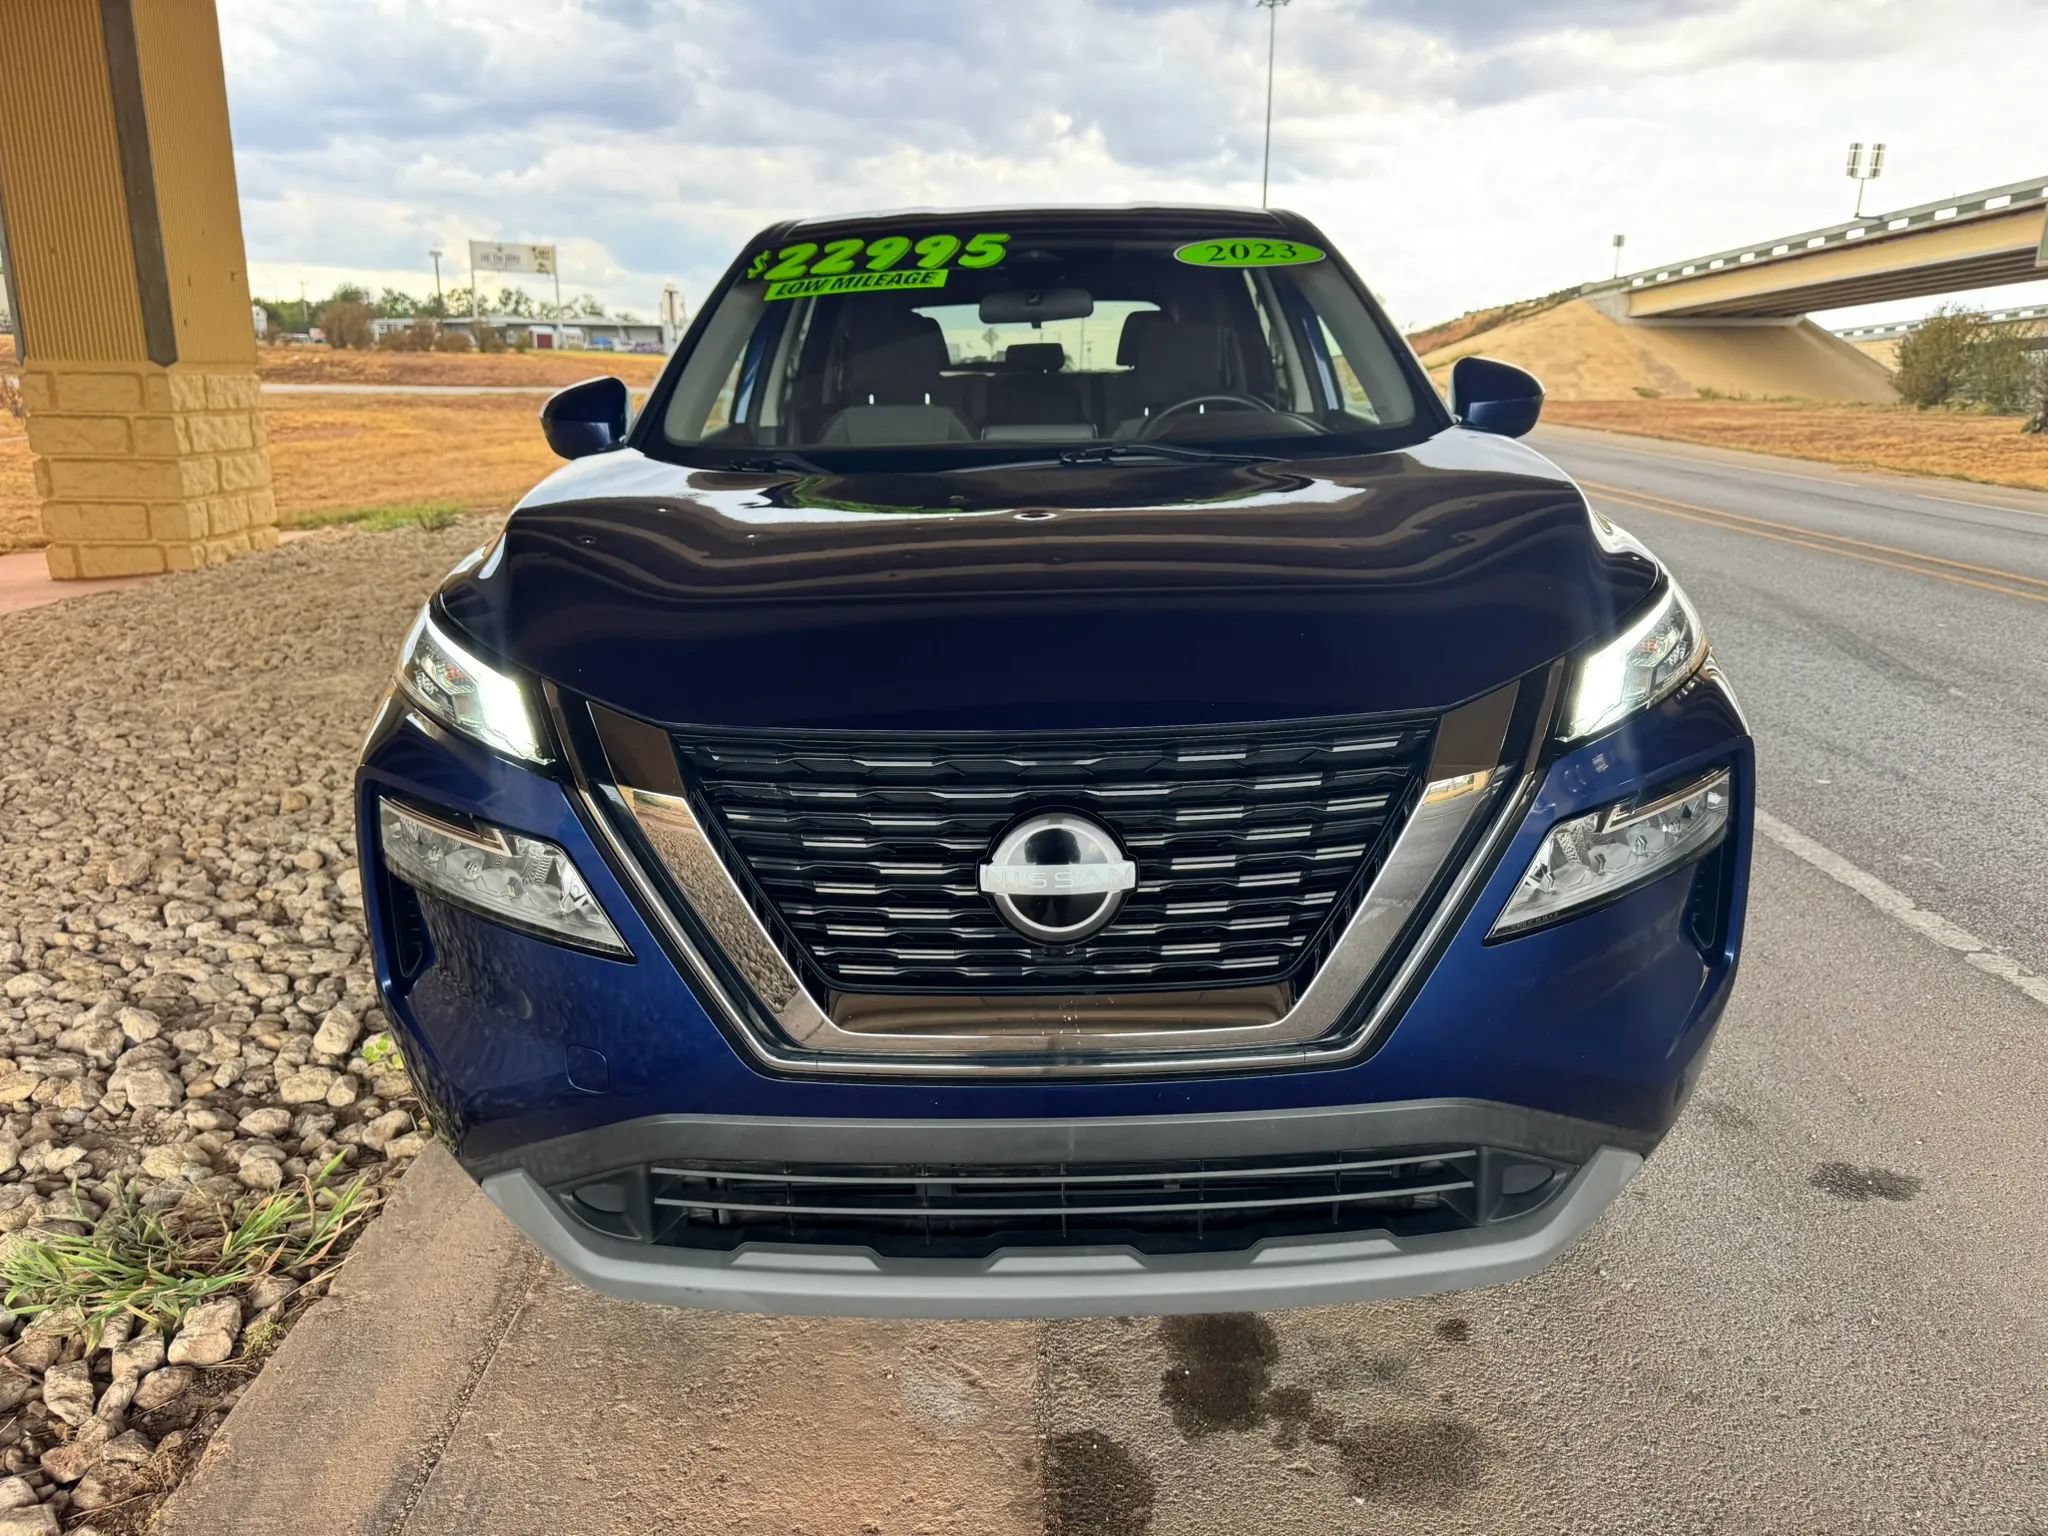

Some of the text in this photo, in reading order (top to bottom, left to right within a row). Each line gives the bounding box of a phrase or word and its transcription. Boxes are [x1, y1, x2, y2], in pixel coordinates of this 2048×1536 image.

[1205, 243, 1297, 262] 2023
[775, 271, 937, 297] LOW MILEAGE
[983, 866, 1132, 889] NISSAN
